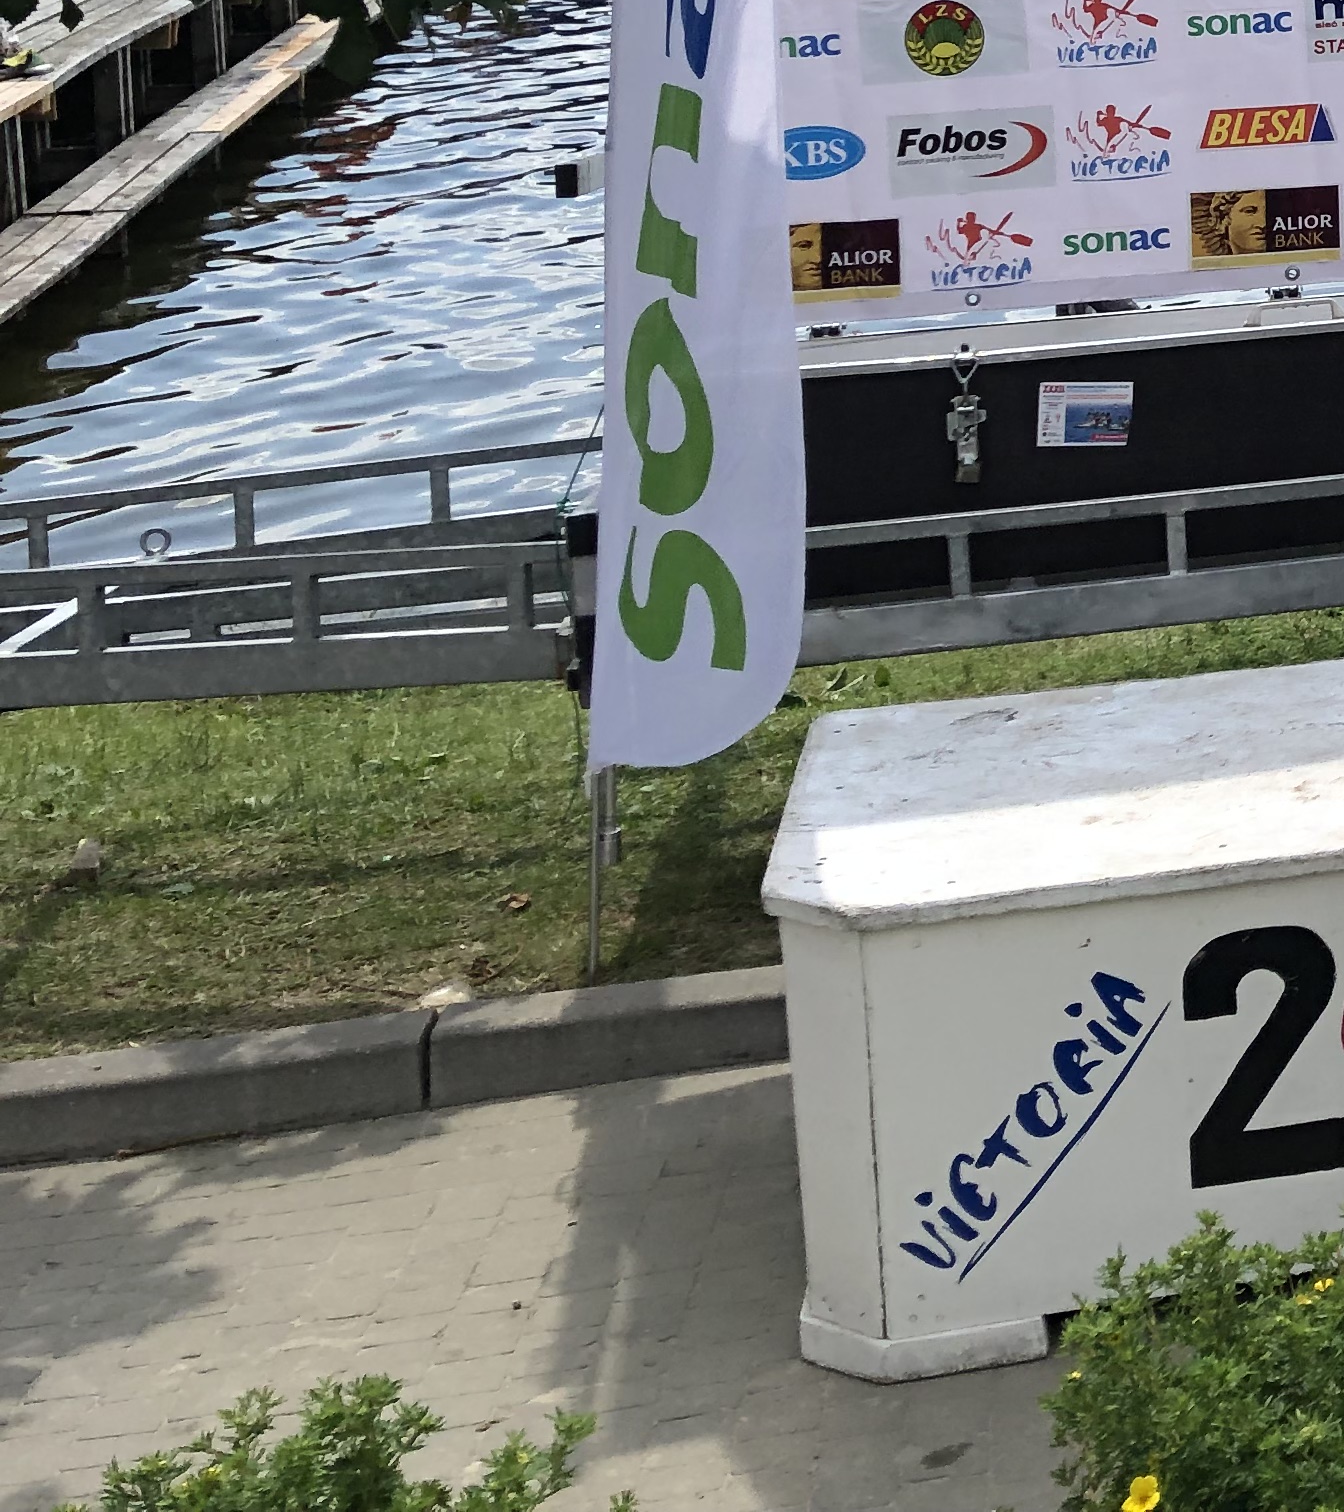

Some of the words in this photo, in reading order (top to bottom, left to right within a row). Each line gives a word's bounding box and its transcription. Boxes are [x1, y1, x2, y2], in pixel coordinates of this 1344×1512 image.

[918, 5, 967, 25] LZS
[1188, 10, 1292, 36] sonac
[1207, 108, 1306, 145] BLESA
[897, 126, 1007, 157] Fobos
[1273, 214, 1333, 231] ALIOR
[1063, 228, 1171, 255] sonac
[1275, 232, 1325, 248] BANK
[828, 249, 892, 267] ALIOR
[831, 268, 884, 283] BANK
